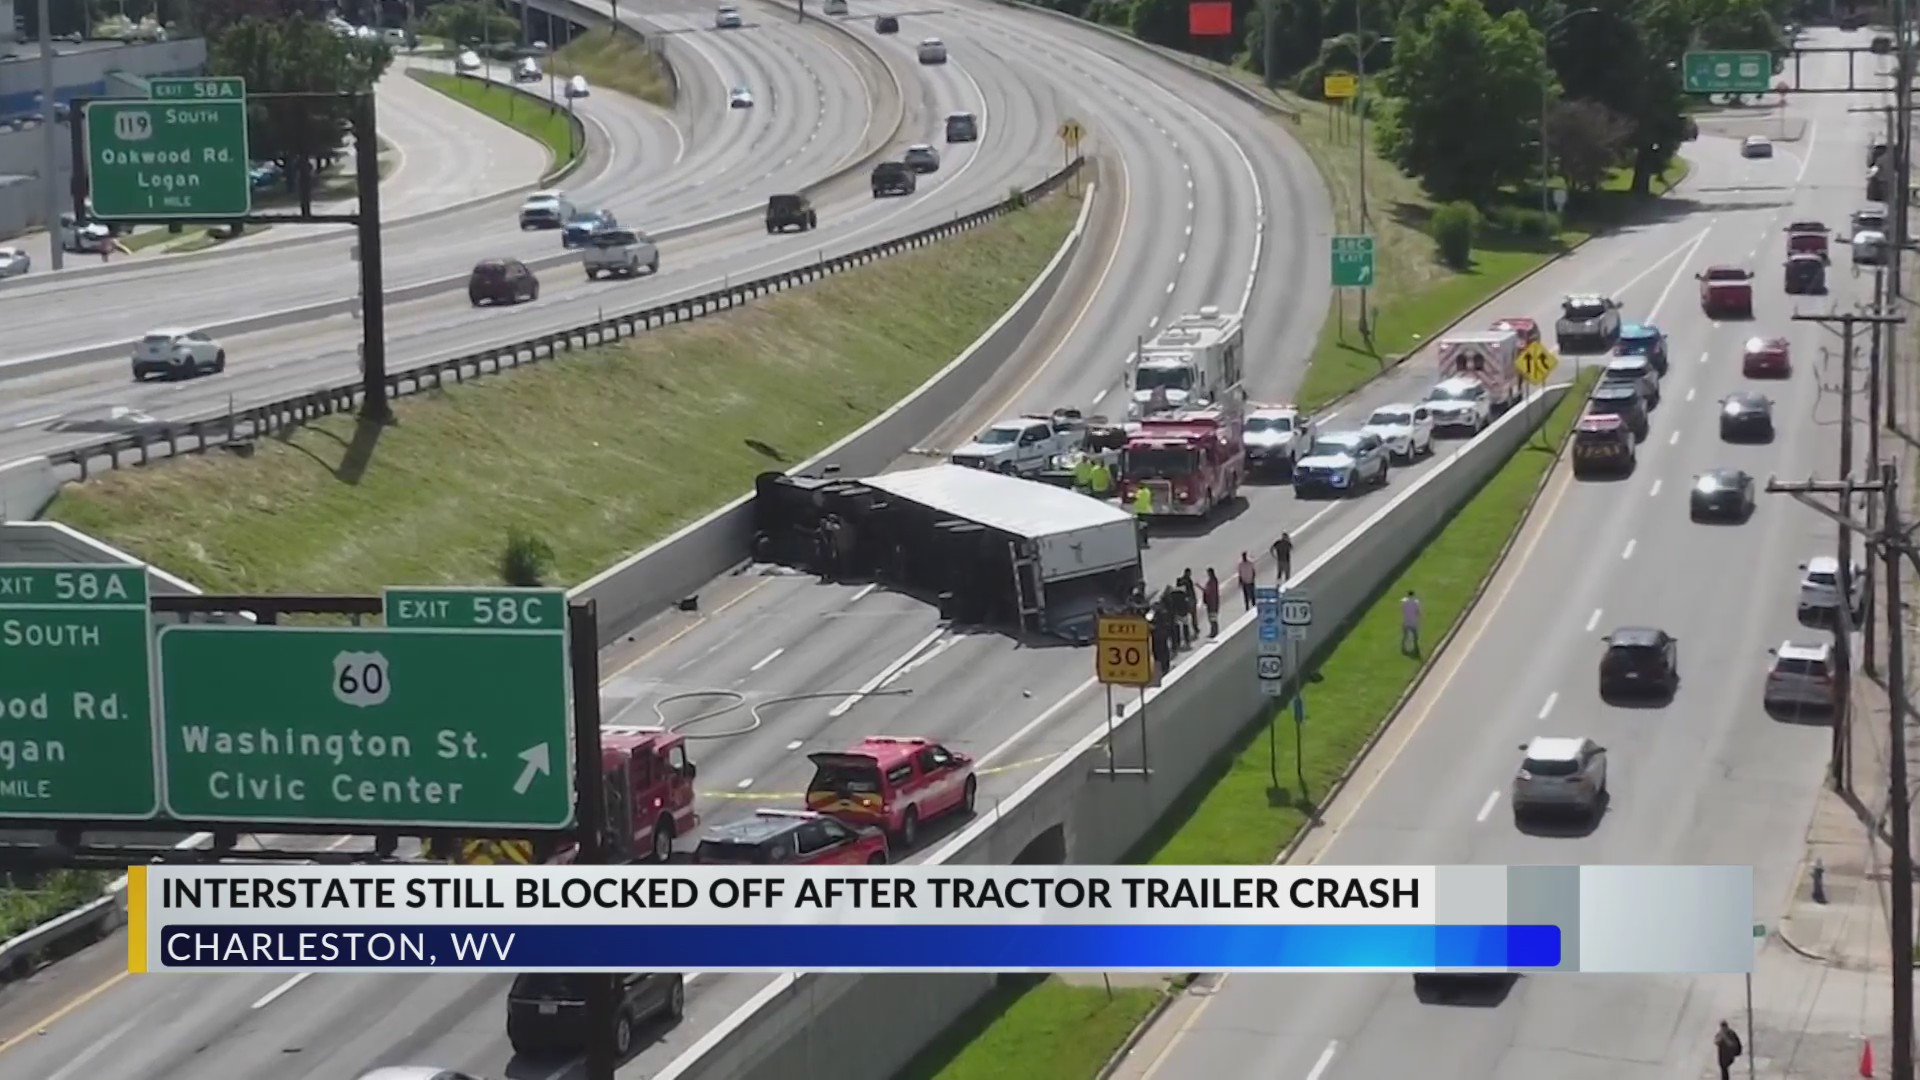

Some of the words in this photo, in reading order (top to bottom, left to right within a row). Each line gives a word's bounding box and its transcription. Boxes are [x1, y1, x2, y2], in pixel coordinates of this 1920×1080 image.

[193, 82, 233, 98] 58A
[120, 116, 148, 133] 119
[102, 148, 191, 165] Oakwood
[203, 147, 234, 163] Rd.
[138, 171, 200, 192] Logan
[148, 194, 154, 209] 1
[163, 196, 192, 208] MILE
[55, 573, 128, 600] 58A
[398, 600, 450, 619] EXIT
[473, 597, 543, 625] 58C
[1286, 605, 1308, 619] 119
[1108, 624, 1136, 633] EXIT
[1108, 647, 1140, 666] 30
[339, 662, 383, 694] 60
[73, 692, 128, 720] Rd.
[181, 725, 411, 766] Washington
[437, 729, 488, 759] St.
[209, 771, 305, 801] Civic
[331, 773, 463, 804] Center
